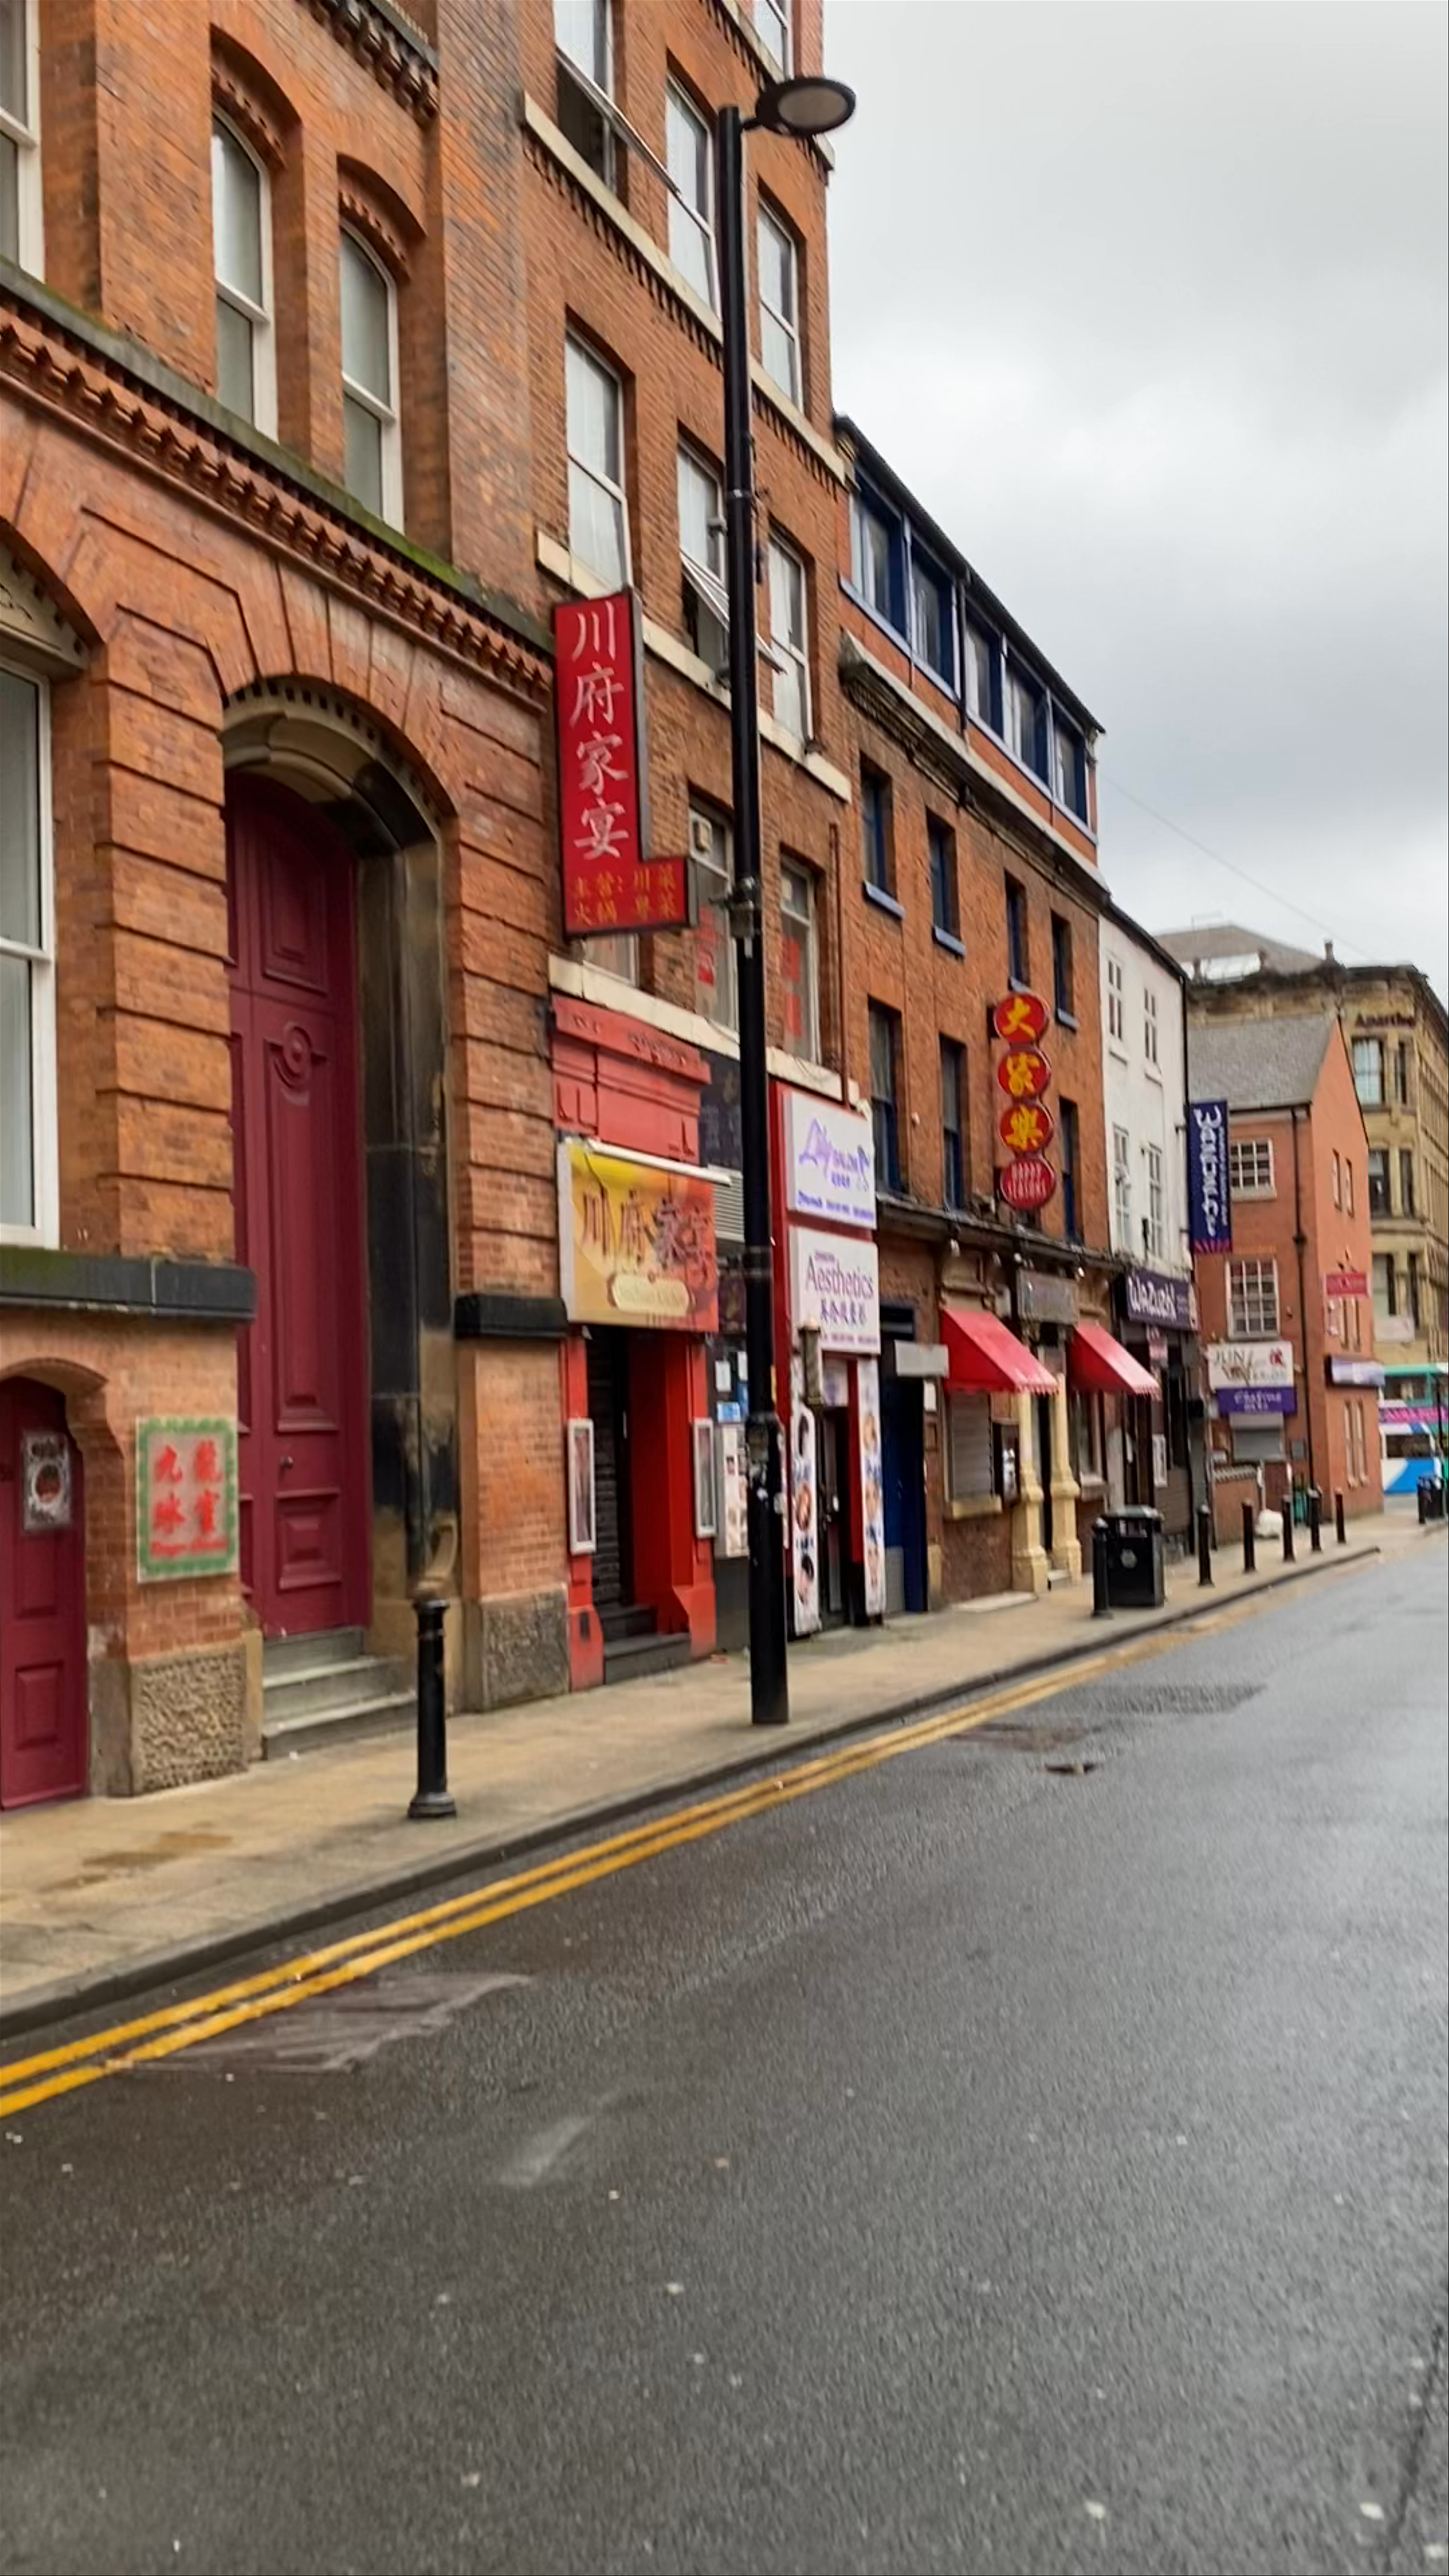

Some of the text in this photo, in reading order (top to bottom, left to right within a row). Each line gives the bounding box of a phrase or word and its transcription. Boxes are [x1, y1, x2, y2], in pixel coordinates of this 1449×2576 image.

[569, 600, 629, 860] 川府家宴
[806, 1254, 874, 1300] Aesthetics
